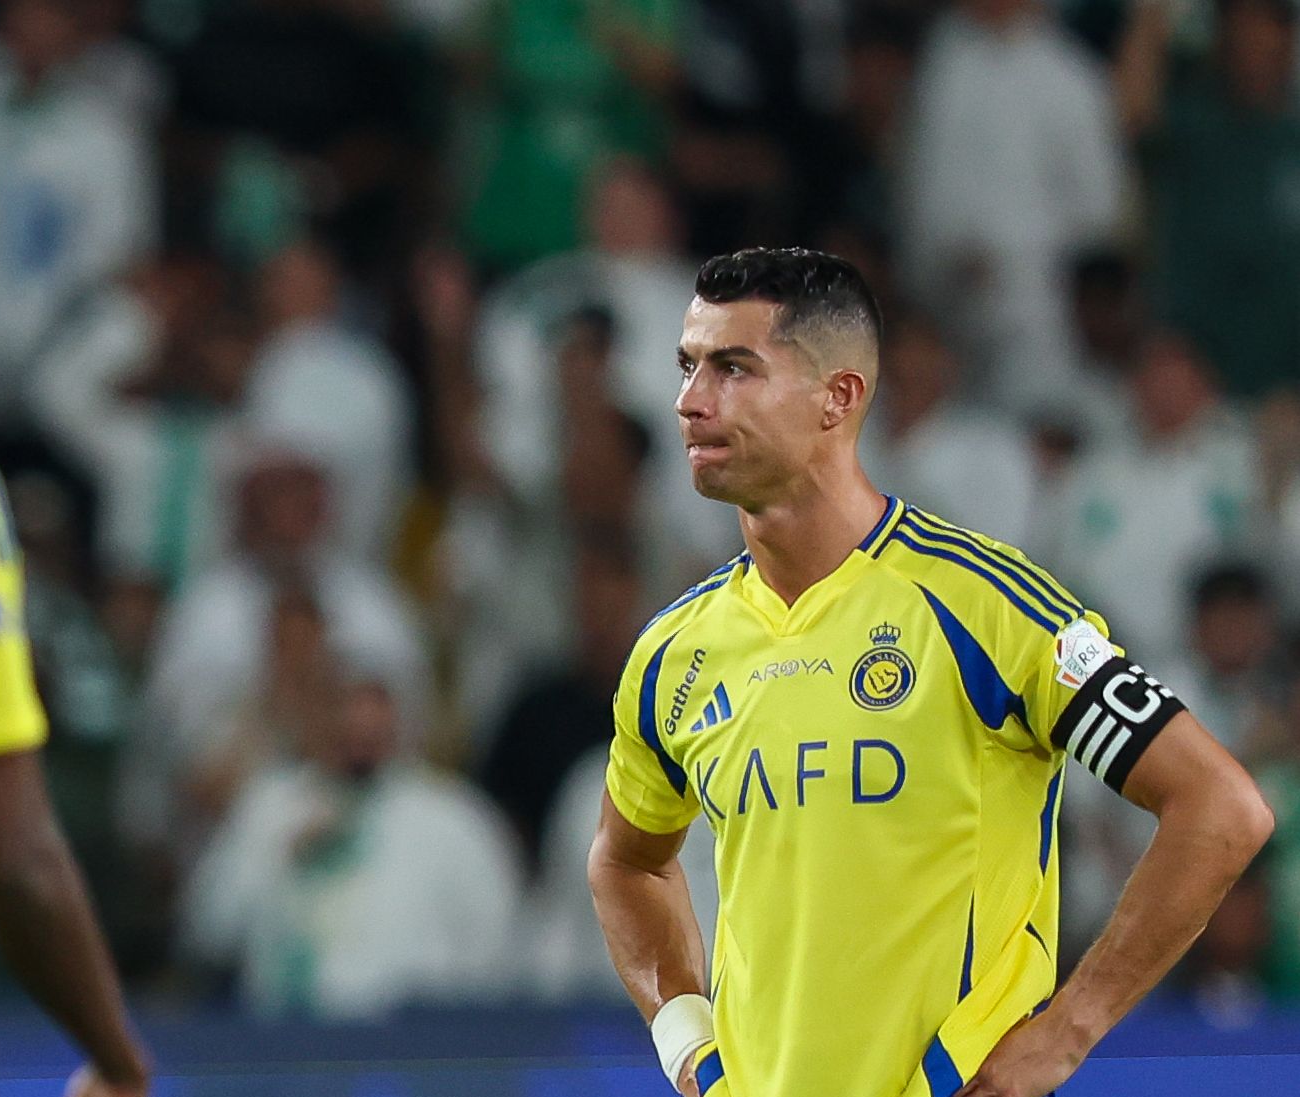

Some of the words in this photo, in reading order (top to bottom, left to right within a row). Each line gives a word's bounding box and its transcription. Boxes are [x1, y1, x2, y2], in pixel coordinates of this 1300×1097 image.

[1078, 644, 1101, 667] RSL
[664, 648, 706, 736] Gathern
[1103, 672, 1162, 724] C
[696, 738, 907, 820] KAFD
